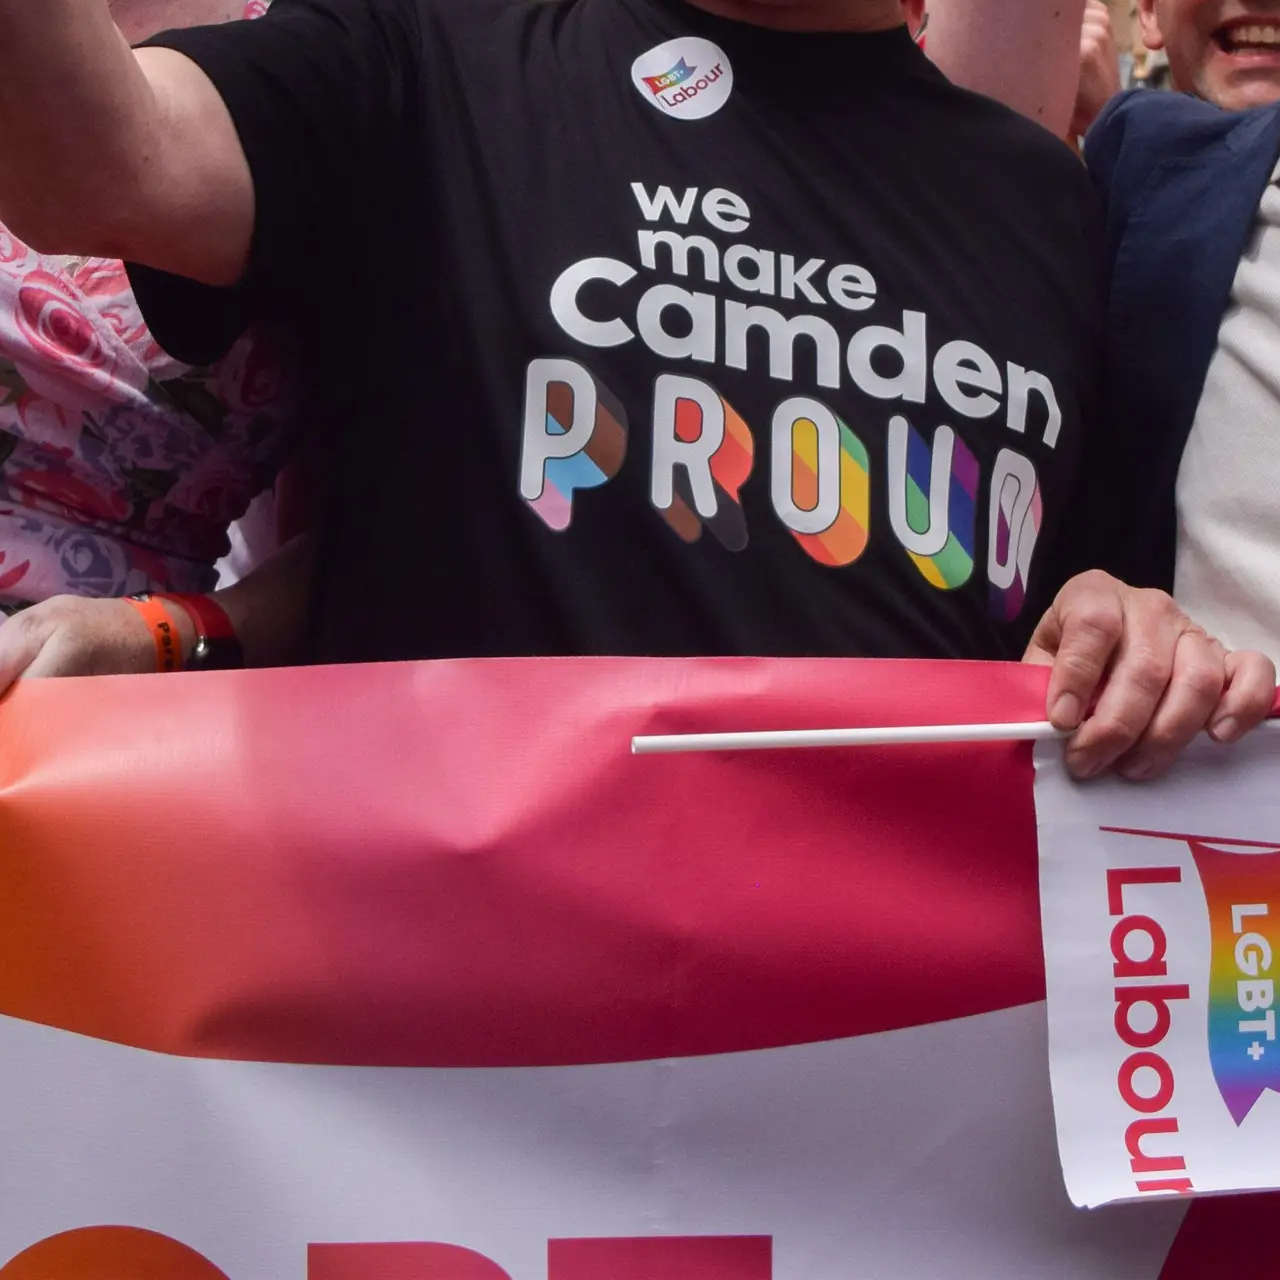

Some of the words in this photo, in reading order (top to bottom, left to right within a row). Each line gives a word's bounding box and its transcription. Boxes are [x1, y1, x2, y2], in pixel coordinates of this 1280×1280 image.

[660, 62, 724, 107] Labour
[630, 181, 751, 233] we
[637, 228, 877, 312] make
[549, 256, 1063, 450] Camden
[519, 357, 1044, 612] PROUD
[1106, 866, 1195, 1194] Labour
[1230, 903, 1276, 1061] LGBT+
